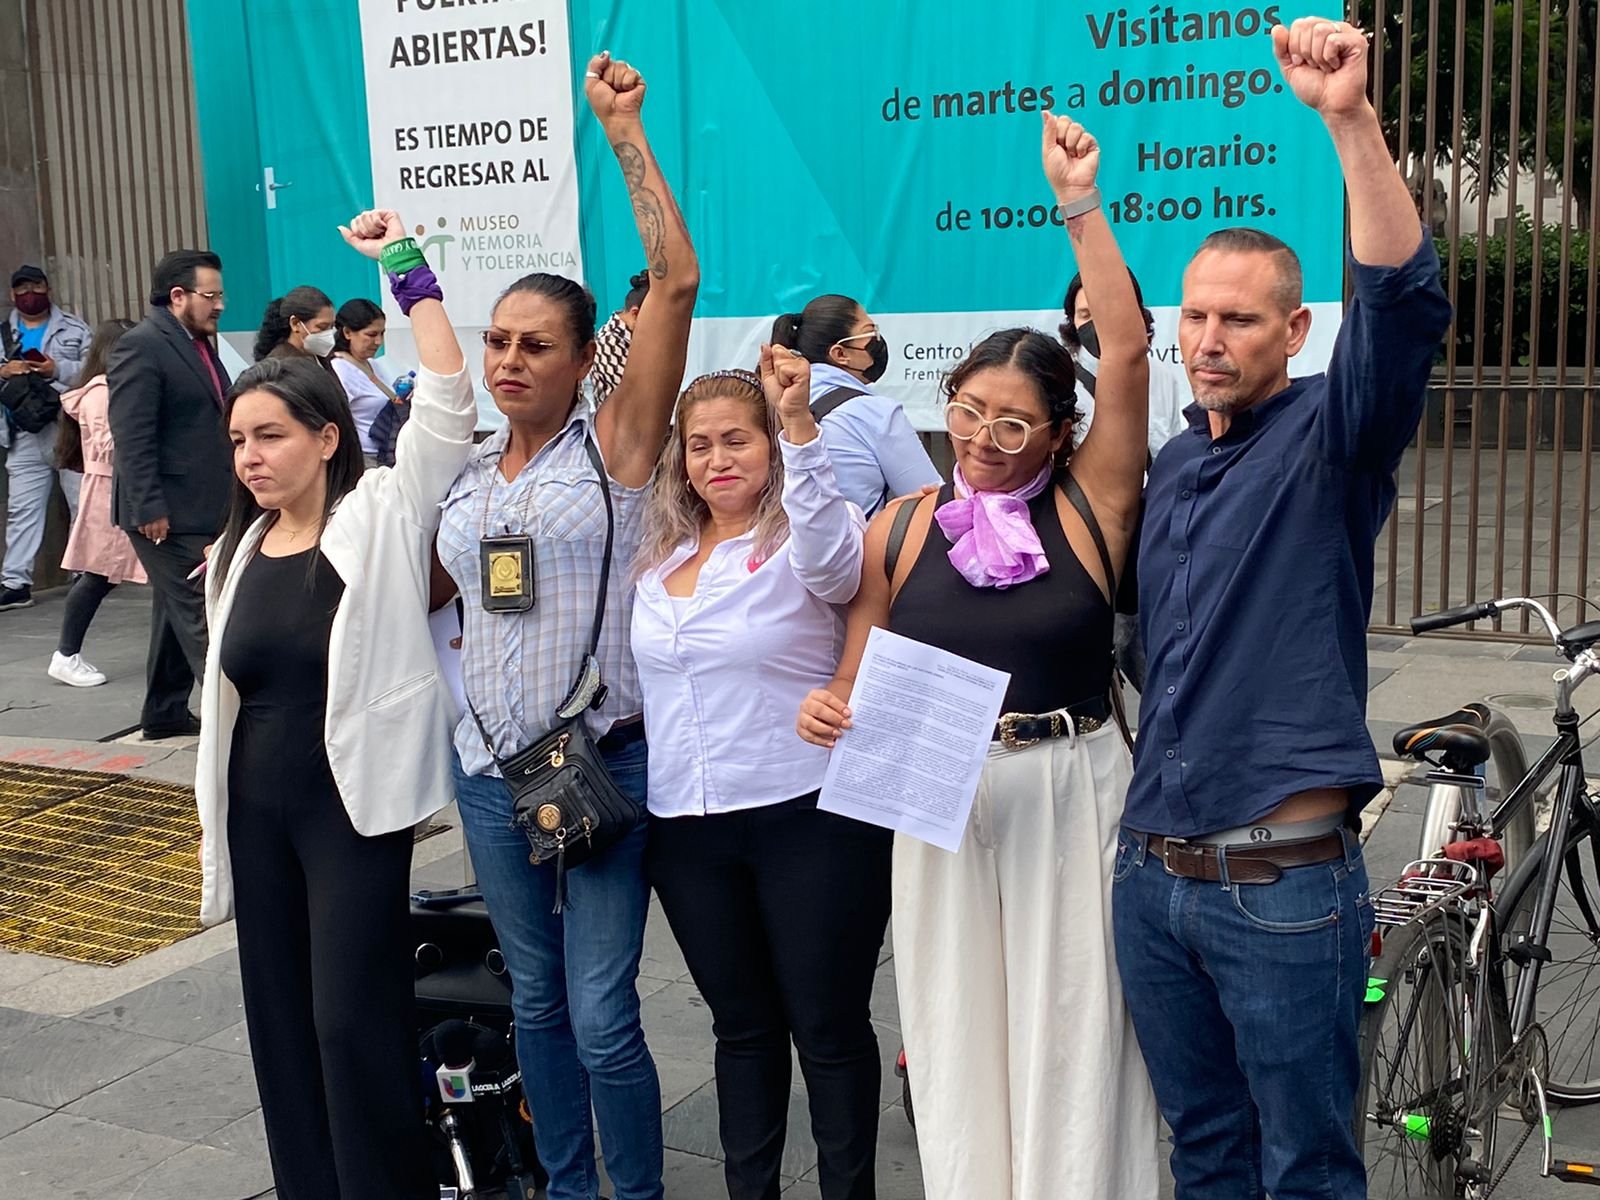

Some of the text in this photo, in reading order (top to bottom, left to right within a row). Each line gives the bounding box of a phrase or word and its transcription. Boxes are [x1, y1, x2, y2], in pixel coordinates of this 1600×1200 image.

[389, 19, 547, 68] ABIERTAS!
[1085, 4, 1281, 50] Visítanos
[881, 64, 1283, 123] de martes a domingo.
[394, 117, 548, 151] ES TIEMPO DE
[1137, 134, 1277, 172] Horario:
[399, 158, 549, 190] REGRESAR AL
[459, 214, 520, 232] MUSEO
[935, 200, 971, 231] de
[1109, 192, 1201, 224] 18:00
[1213, 186, 1277, 218] hrs.
[461, 234, 543, 252] MEMORIA
[462, 252, 577, 271] Y TOLERANCIA
[903, 342, 964, 361] Centro
